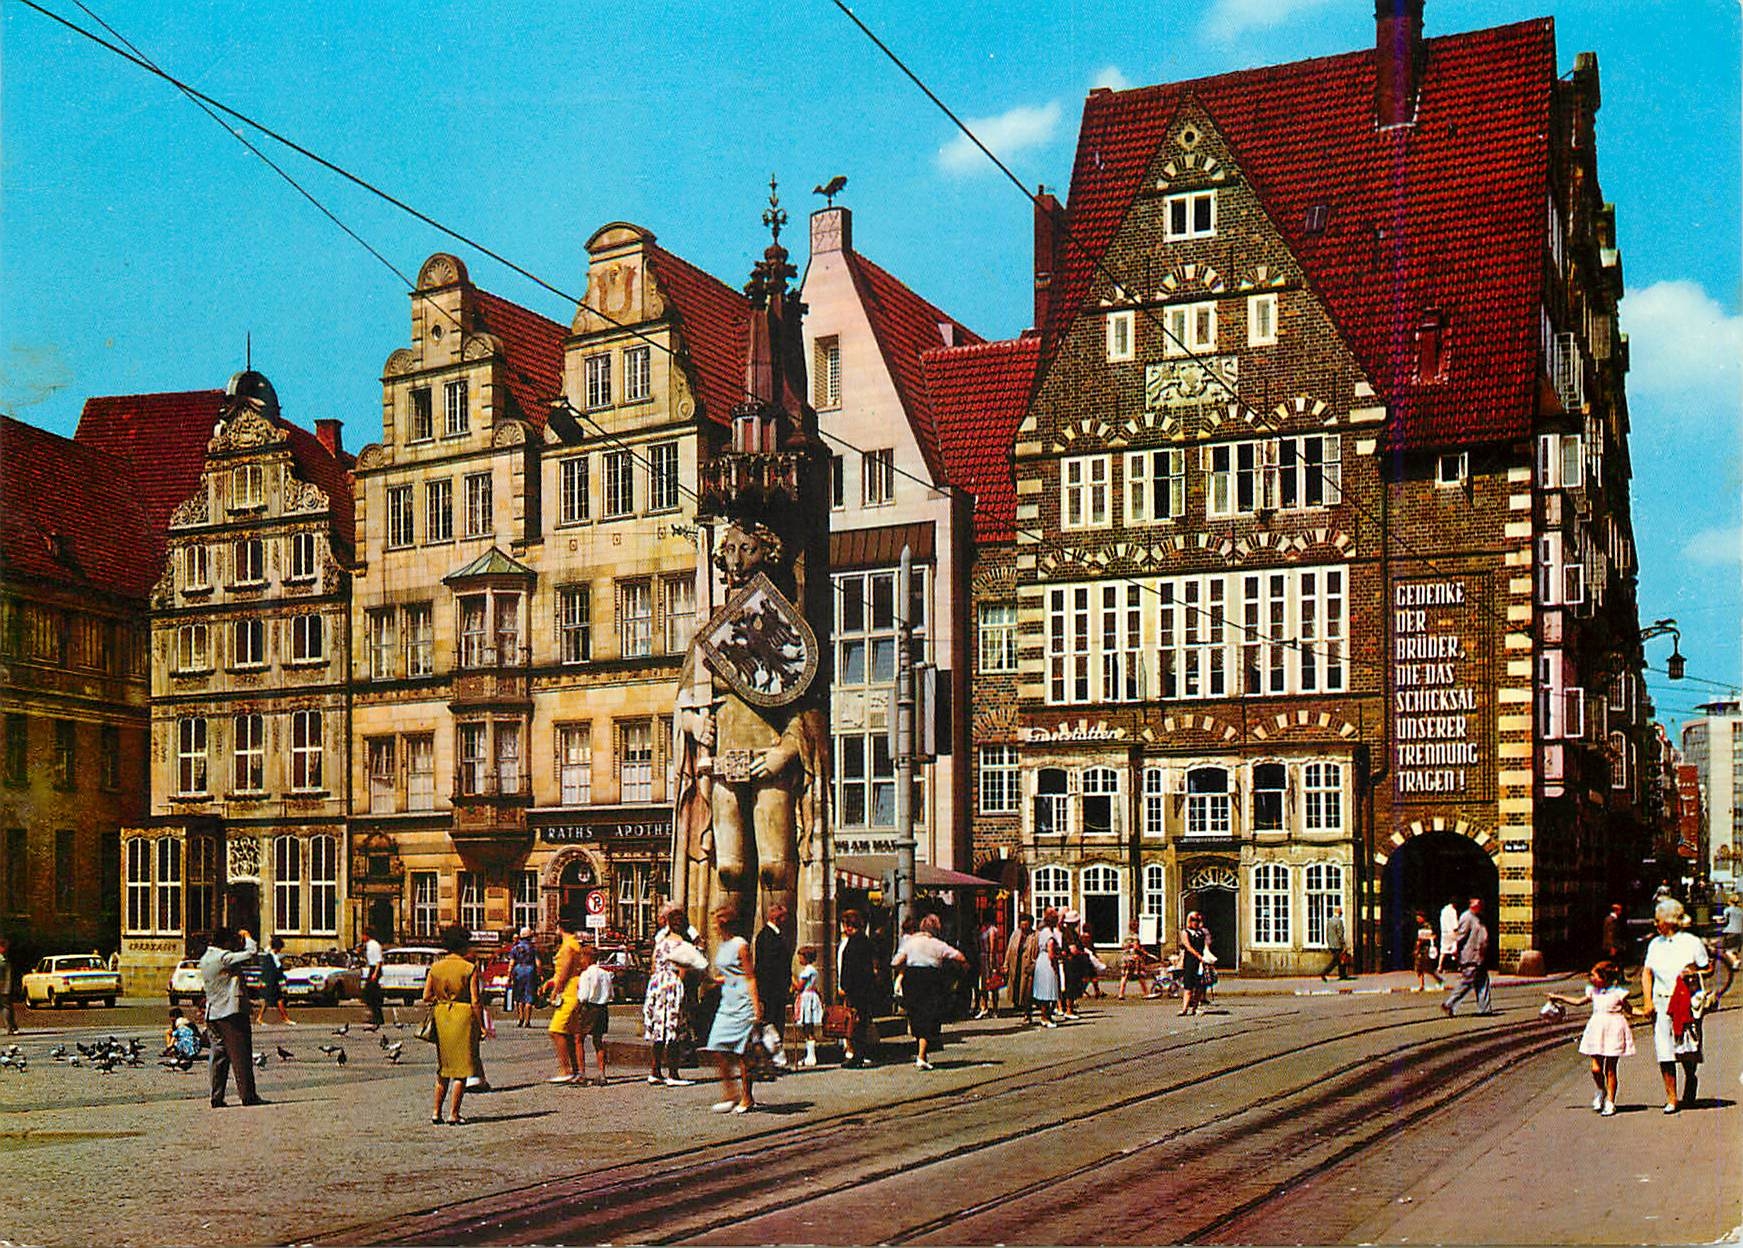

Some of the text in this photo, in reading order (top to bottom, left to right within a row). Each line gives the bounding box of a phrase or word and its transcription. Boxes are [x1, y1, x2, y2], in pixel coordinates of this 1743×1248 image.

[1396, 582, 1465, 605] GEDENKE
[1396, 610, 1427, 633] DER
[1396, 635, 1466, 660] BRÜDER,
[1396, 663, 1454, 686] DIE DAS
[1396, 688, 1477, 712] SCHICKSAL
[1396, 716, 1467, 739] UNSERER
[1397, 742, 1478, 766] TRENNUNG
[548, 823, 673, 839] RATHS APOTHE
